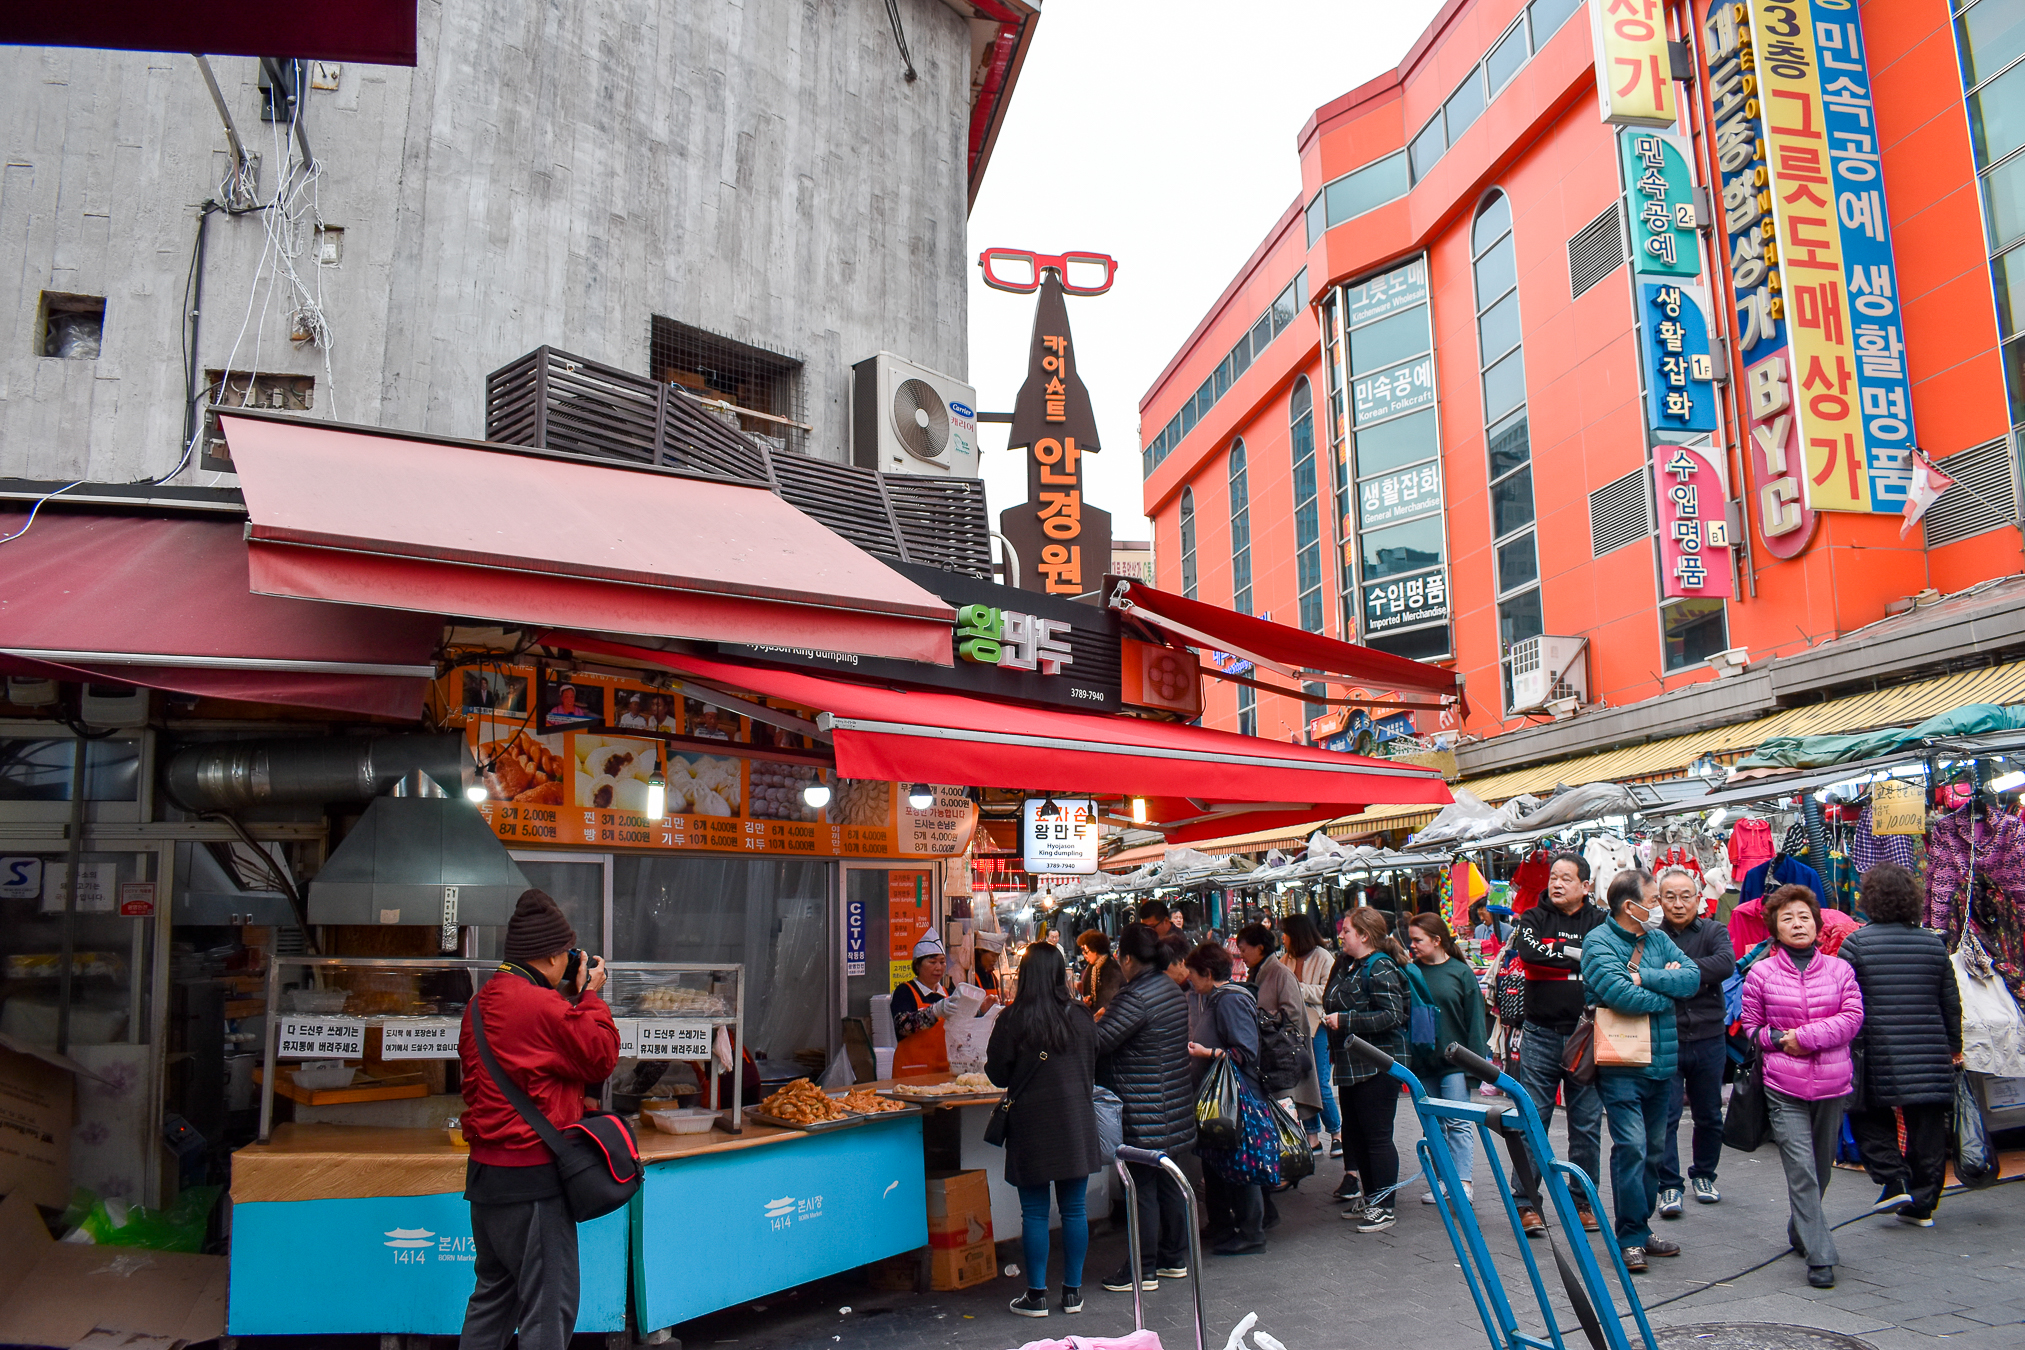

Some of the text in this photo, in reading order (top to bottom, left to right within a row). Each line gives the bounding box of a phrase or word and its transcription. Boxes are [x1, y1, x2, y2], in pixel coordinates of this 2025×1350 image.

[1815, 21, 1886, 243] 민속공예
[1703, 4, 1776, 351] 대도종합상가
[1634, 136, 1677, 267] 민속공예
[1677, 204, 1695, 226] 2F
[1771, 89, 1862, 500] 그릇도매상가
[1352, 287, 1426, 323] Kitchenware Wholesale
[1655, 287, 1694, 422] 생활잡화
[1692, 355, 1711, 378] 1F
[1356, 360, 1432, 410] 민속공예
[1848, 264, 1913, 502] 생활명품
[952, 403, 972, 416] Carrier
[1358, 391, 1433, 422] Korean Folkcraft
[1748, 356, 1803, 537] BYC
[1363, 465, 1439, 511] 생활잡화
[1034, 437, 1083, 594] 안경원
[1364, 497, 1441, 524] General Merchandise
[1665, 448, 1709, 591] 수입명품
[1711, 522, 1727, 545] B1
[1368, 574, 1446, 616] 수입명품
[1369, 605, 1448, 630] Imported Merchandise
[957, 603, 1074, 676] 왕만두
[1070, 687, 1105, 702] 3789-7940
[940, 798, 970, 809] 6,000원
[501, 807, 557, 822] 3개 2,000원
[601, 814, 650, 828] 3개 2,000원
[929, 808, 966, 819] 가능합니다
[499, 823, 557, 838] 8개 5,000원
[693, 820, 738, 834] 6개 4,000원
[771, 825, 815, 838] 6개 4,000원
[914, 819, 957, 831] 드시는 손님은
[601, 829, 651, 842] 8개 5,000원
[689, 834, 738, 848] 10개 6,000원
[847, 829, 887, 842] 6개 4,000원
[913, 831, 959, 842] 5개 4,000원
[768, 839, 816, 851] 10개 6,000원
[843, 842, 888, 854] 10개 6,000원
[914, 842, 956, 853] 8개 6,000원
[1046, 842, 1076, 850] Hyojason
[1038, 849, 1083, 858] King dumpling
[850, 903, 862, 950] CCTV
[287, 1024, 359, 1038] 다 드신후 쓰레기는
[385, 1029, 404, 1038] 도시락
[414, 1028, 437, 1038] 포장손님
[439, 1028, 446, 1038] 은
[643, 1029, 707, 1040] 다 드신후 쓰레기는
[282, 1040, 361, 1054] 휴지통에 버려주세요.
[385, 1042, 409, 1053] 여기에서
[411, 1042, 435, 1052] 드실수가
[640, 1044, 709, 1055] 휴지통에 버려주세요.
[798, 1195, 824, 1214] 본시장
[770, 1215, 792, 1232] 1414
[393, 1249, 426, 1265] 1414
[438, 1254, 456, 1262] BORN
